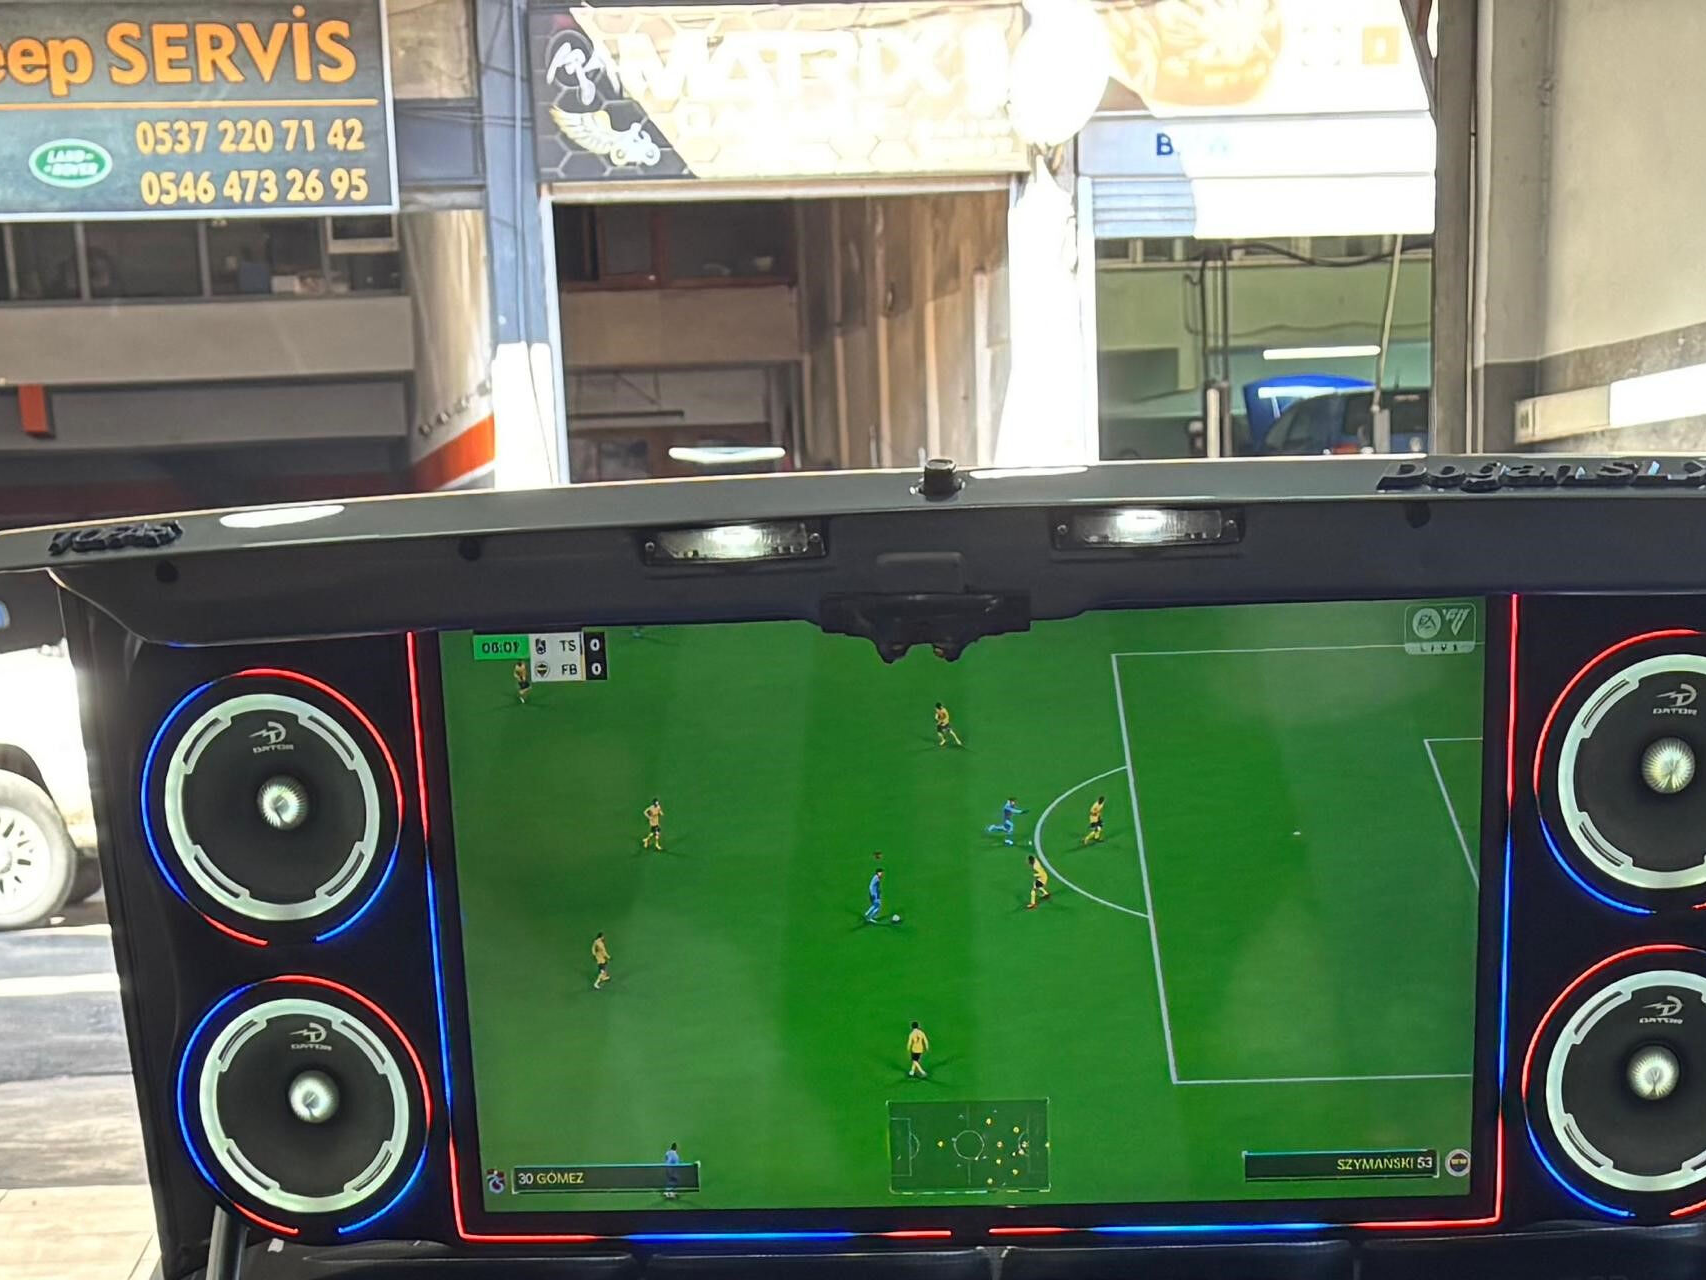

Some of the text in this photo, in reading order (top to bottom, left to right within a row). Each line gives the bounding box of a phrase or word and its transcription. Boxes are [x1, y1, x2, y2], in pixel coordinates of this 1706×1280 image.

[105, 4, 358, 86] SERVİS
[136, 118, 366, 154] 0537 220 71 42
[140, 168, 369, 206] 0546 473 26 95
[559, 639, 577, 652] TS
[590, 638, 600, 652] 0
[561, 662, 602, 676] FB 0
[1417, 1156, 1433, 1169] 53
[518, 1173, 534, 1185] 30
